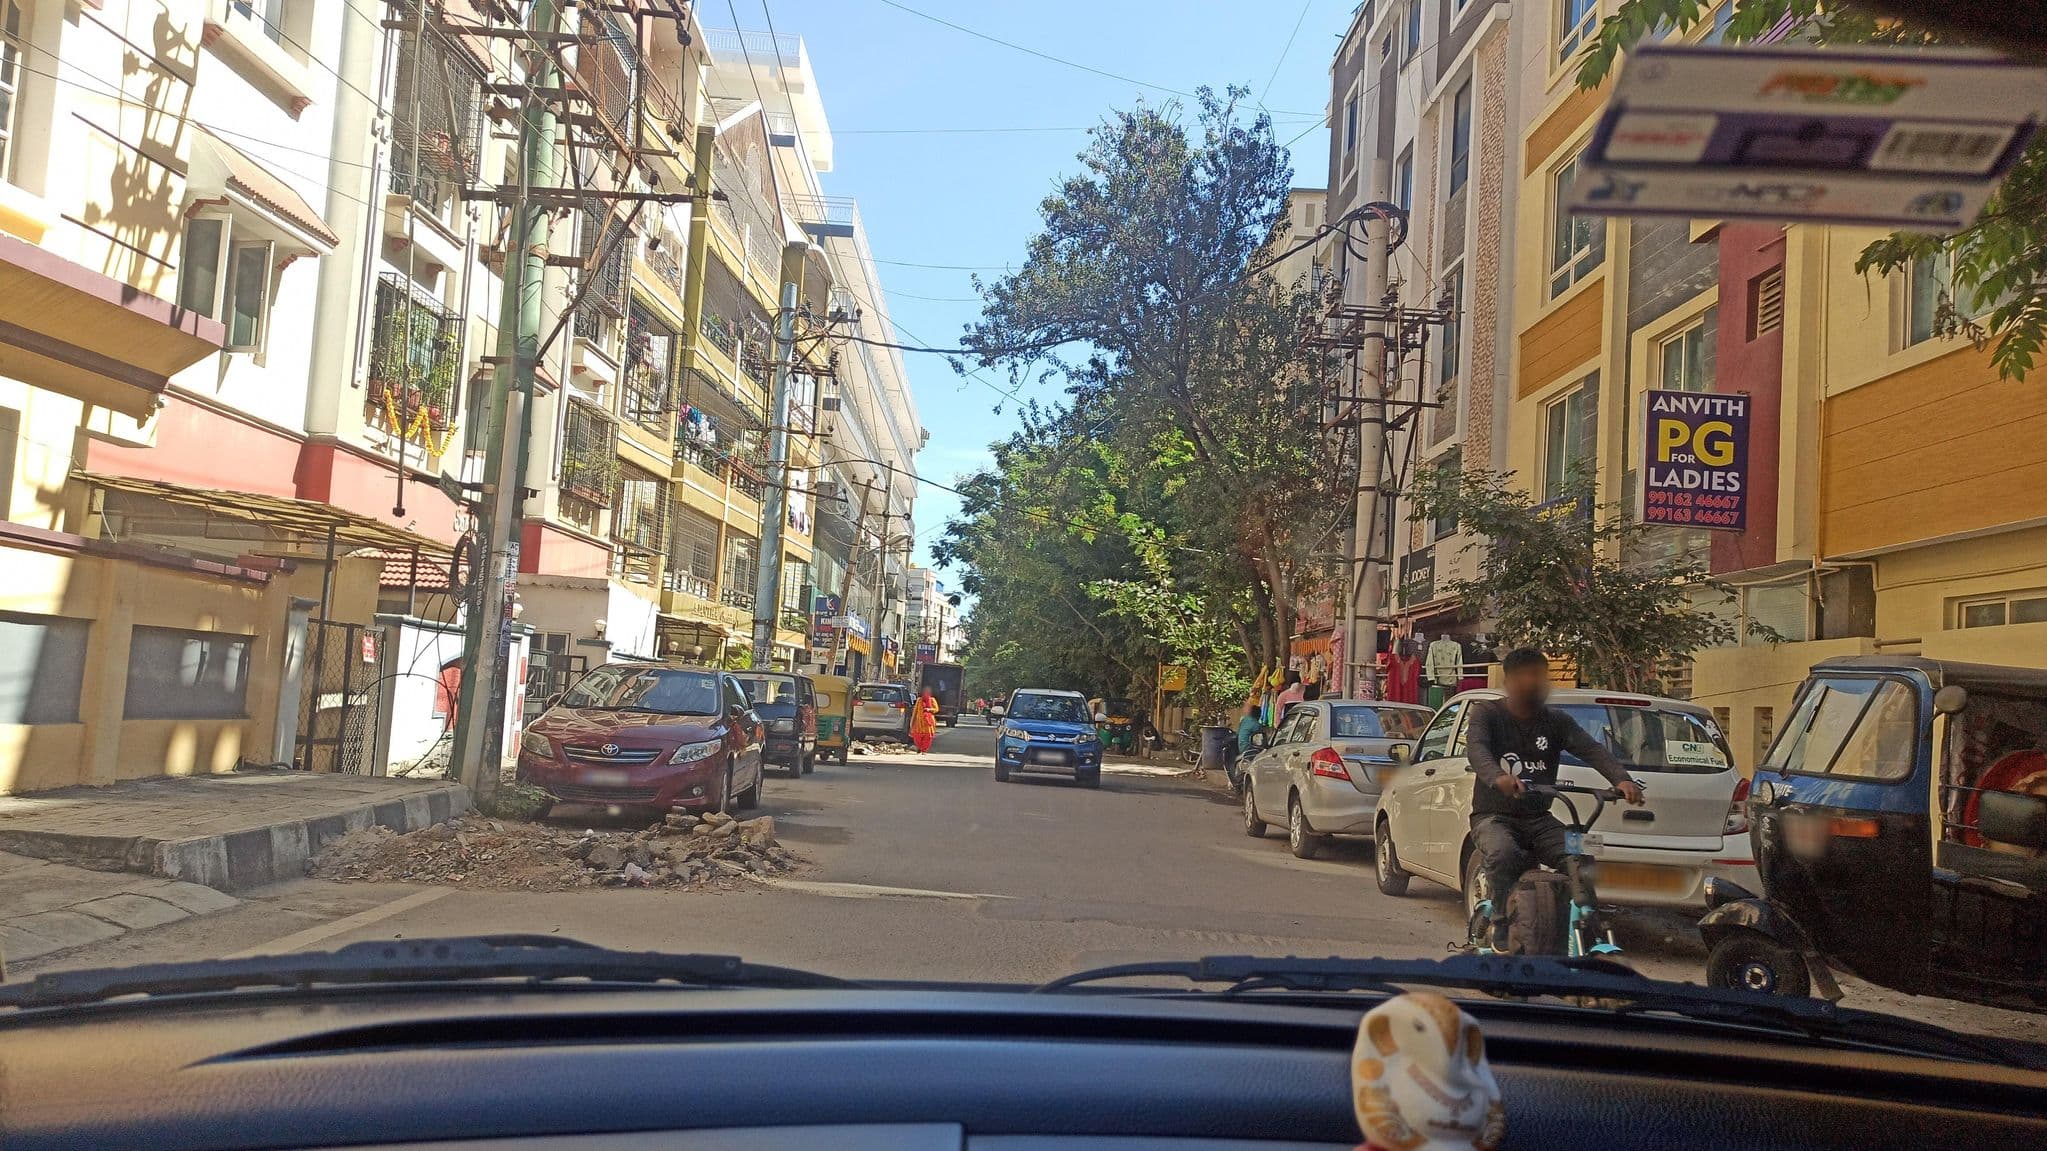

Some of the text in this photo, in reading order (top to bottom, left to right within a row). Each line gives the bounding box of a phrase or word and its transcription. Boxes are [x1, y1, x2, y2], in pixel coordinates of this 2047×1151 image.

[1652, 395, 1744, 417] ANVITH
[1657, 418, 1735, 467] PG
[1671, 453, 1696, 464] FOR
[1649, 467, 1741, 492] LADIES
[1648, 490, 1740, 509] 99162 46667
[1647, 506, 1740, 525] 99163 46667
[1668, 754, 1707, 765] Economical
